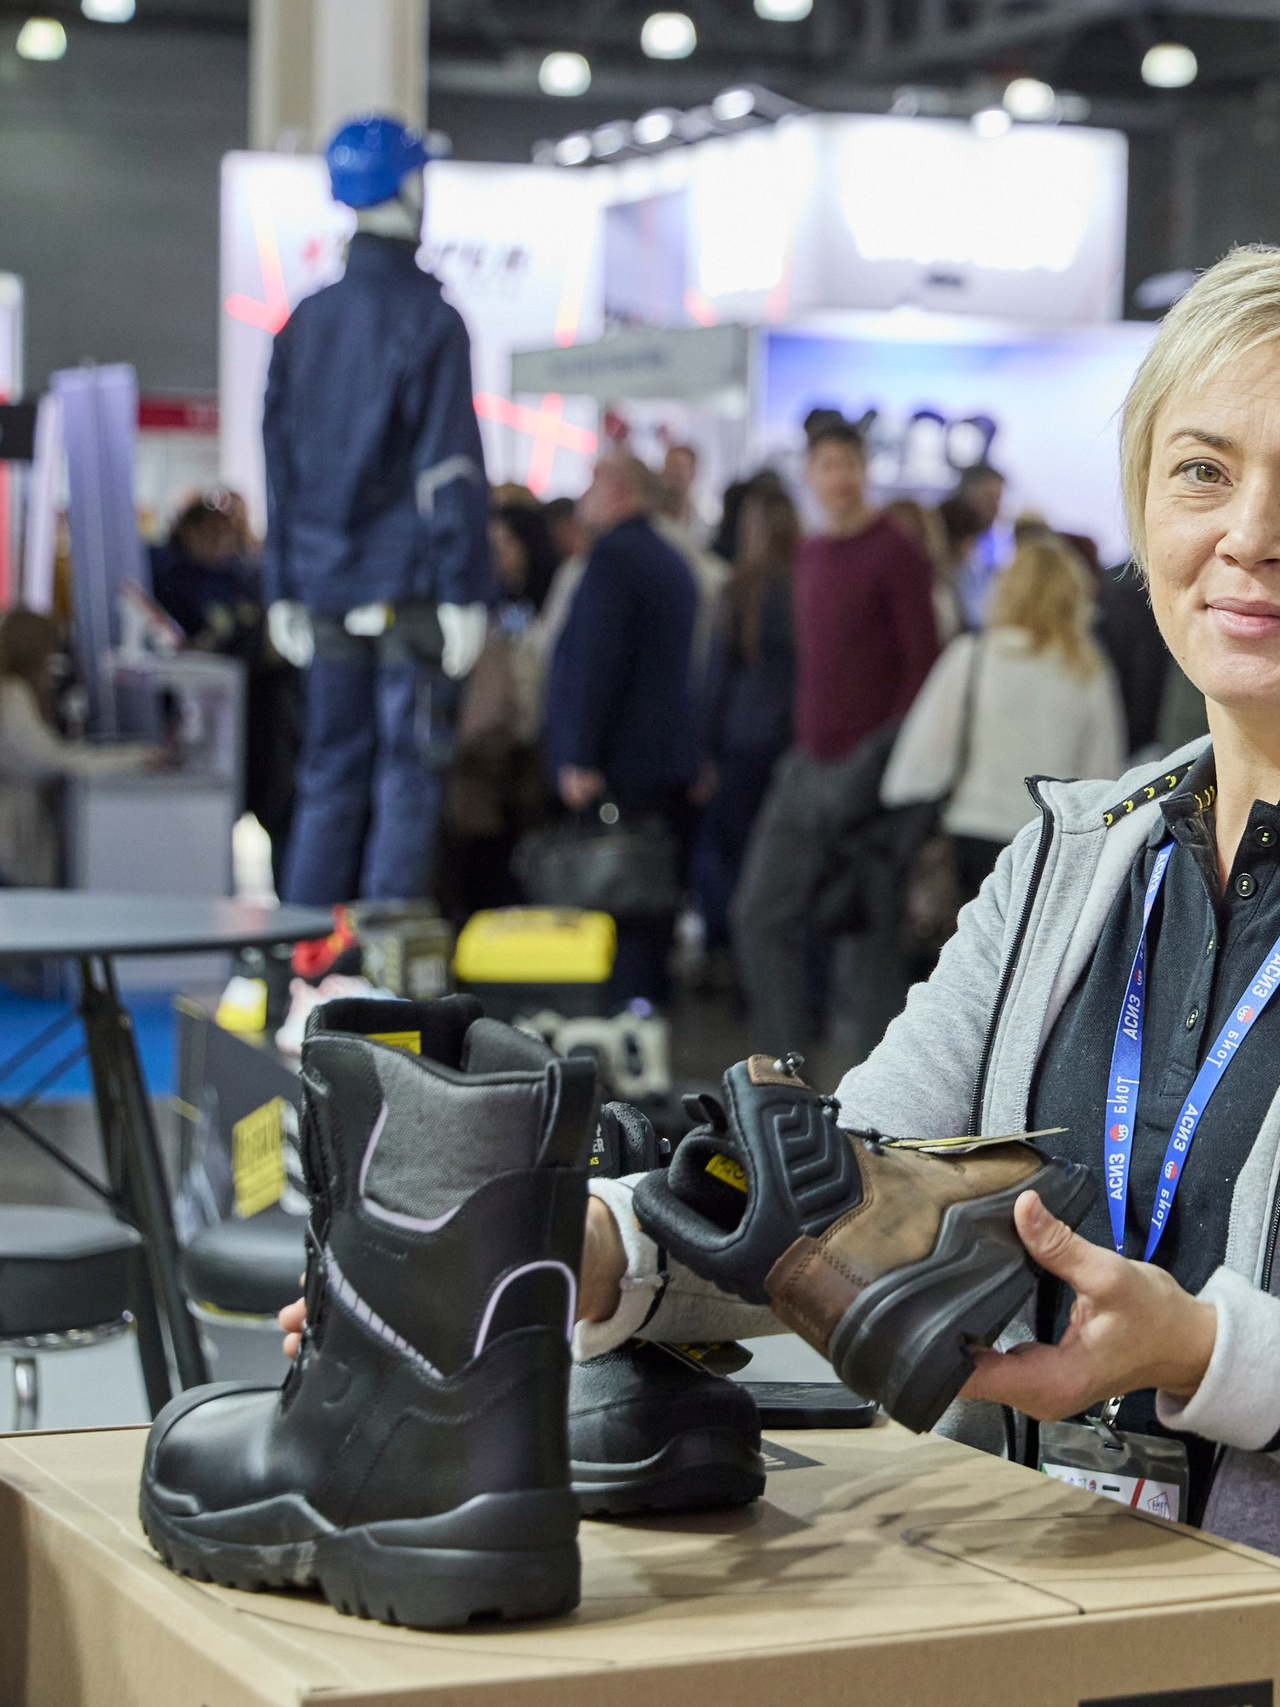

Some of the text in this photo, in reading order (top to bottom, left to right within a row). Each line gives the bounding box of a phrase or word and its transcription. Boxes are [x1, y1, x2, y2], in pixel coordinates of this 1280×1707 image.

[1148, 853, 1169, 894] АСИЗ
[1122, 993, 1142, 1041] АСИЗ
[1173, 1102, 1199, 1152] АСИЗ
[1108, 1152, 1126, 1200] АСИЗ
